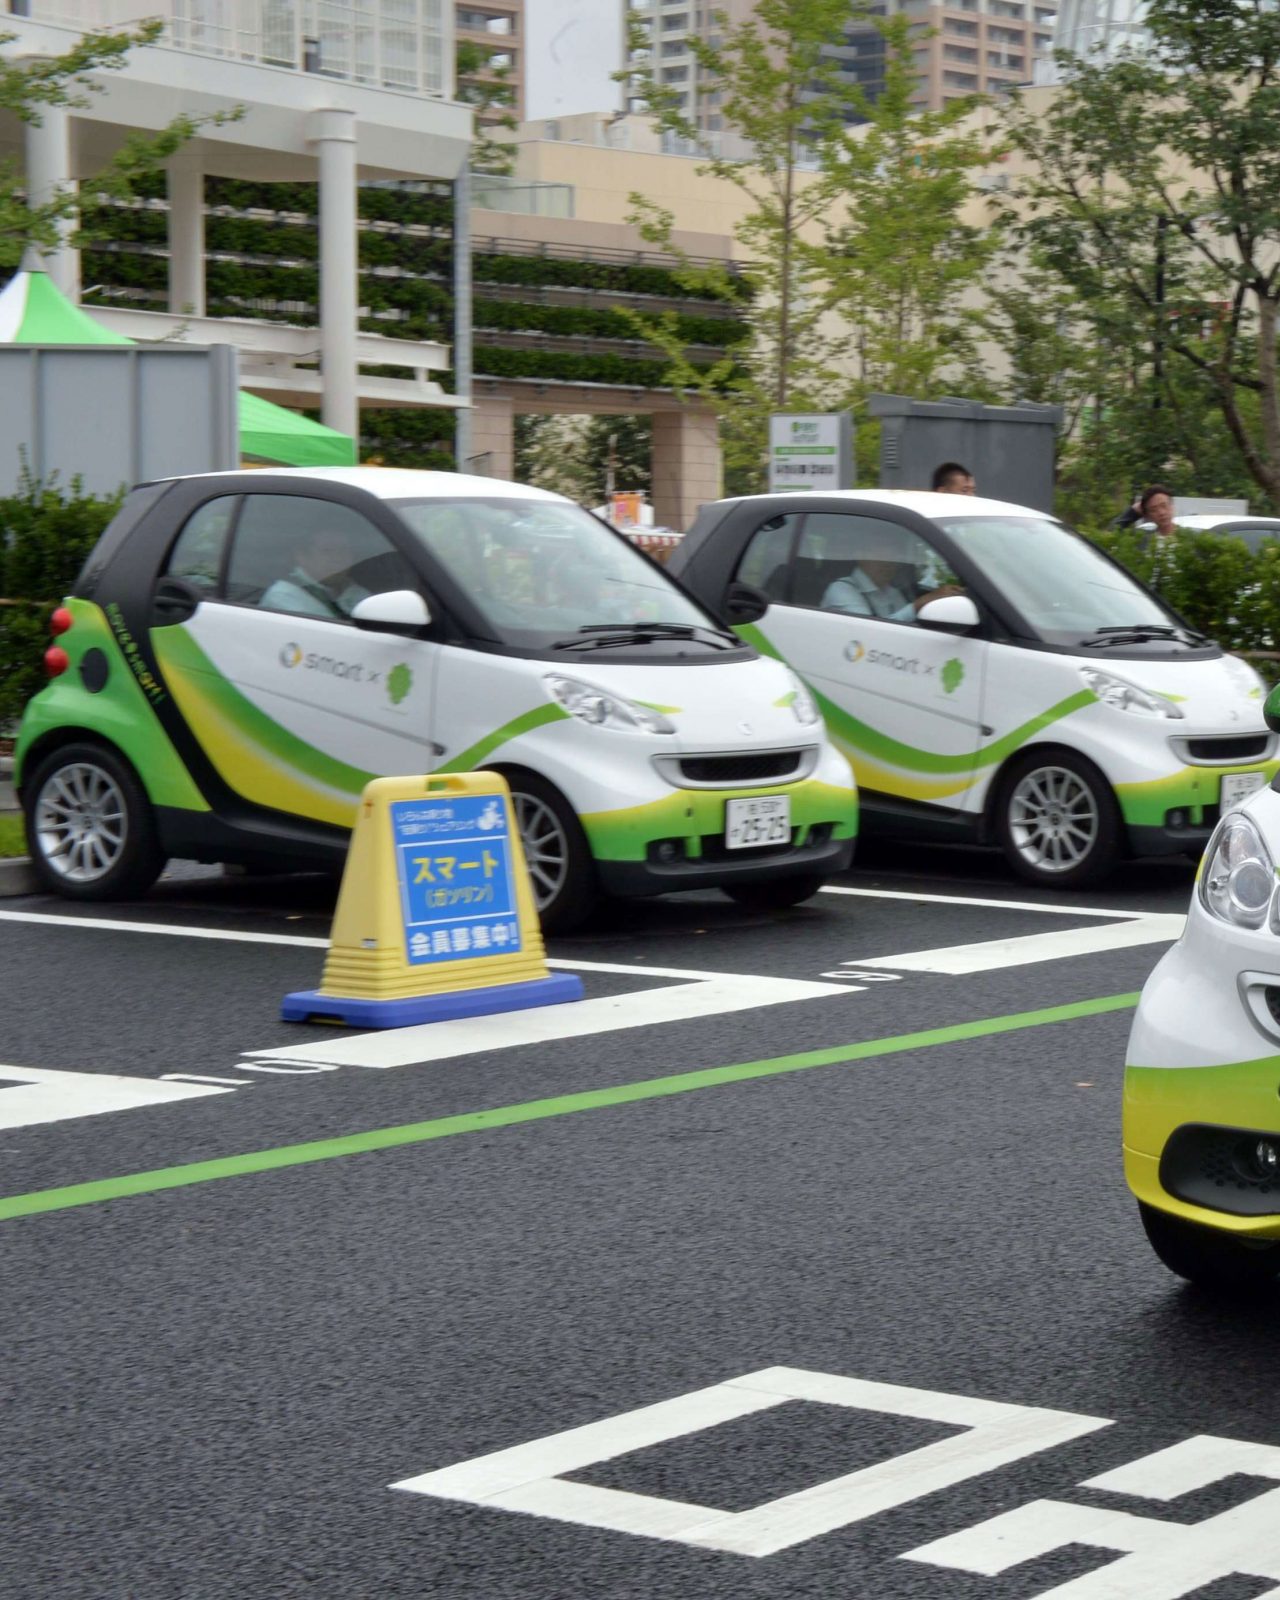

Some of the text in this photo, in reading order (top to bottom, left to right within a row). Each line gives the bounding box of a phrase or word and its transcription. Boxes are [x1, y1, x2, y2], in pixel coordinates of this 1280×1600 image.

[304, 653, 364, 683] smart
[866, 649, 920, 675] smart
[741, 815, 787, 843] 25-25
[412, 850, 499, 885] スマート
